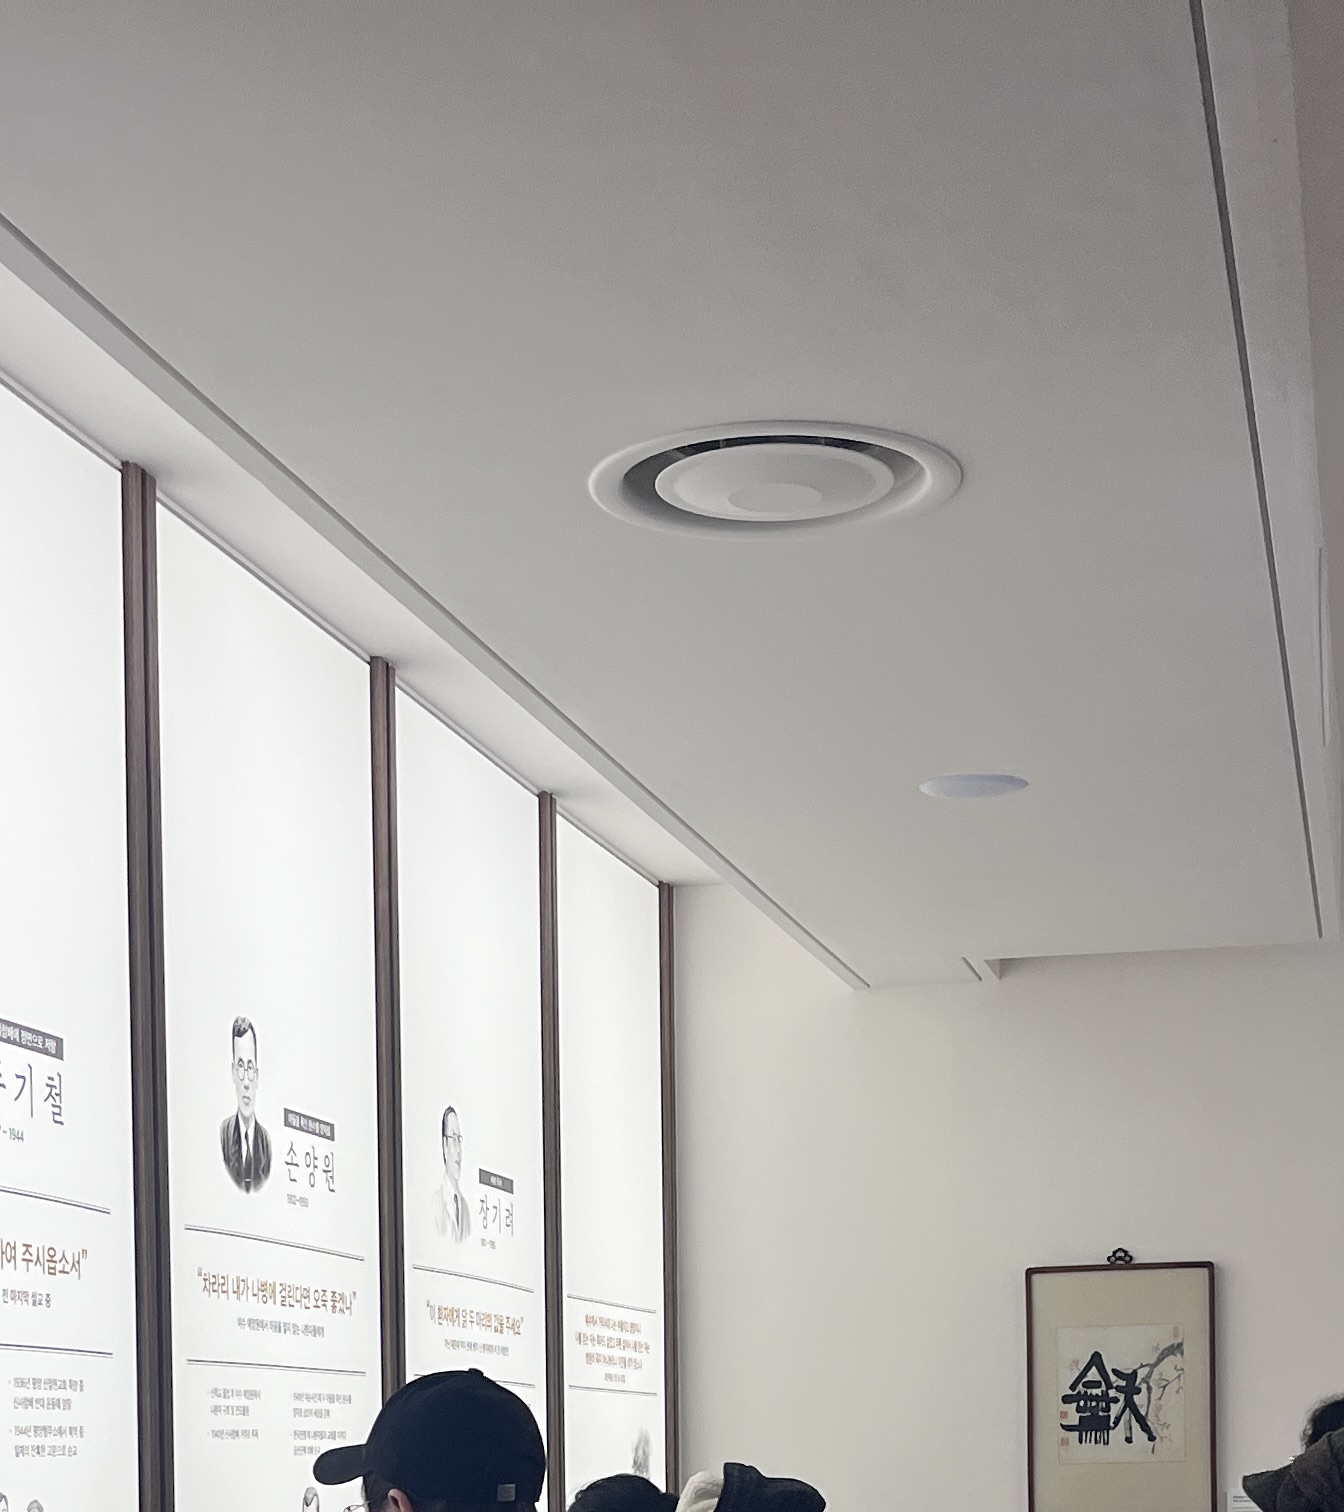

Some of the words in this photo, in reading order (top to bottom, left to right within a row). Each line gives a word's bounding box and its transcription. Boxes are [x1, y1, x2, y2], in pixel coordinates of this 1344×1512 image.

[9, 1127, 24, 1142] 1944
[21, 1243, 88, 1281] 주시옵소서”
[232, 1275, 249, 1303] 내가
[252, 1278, 276, 1306] 나병에
[278, 1281, 311, 1310] 걸린다면
[312, 1288, 328, 1312] 오죽
